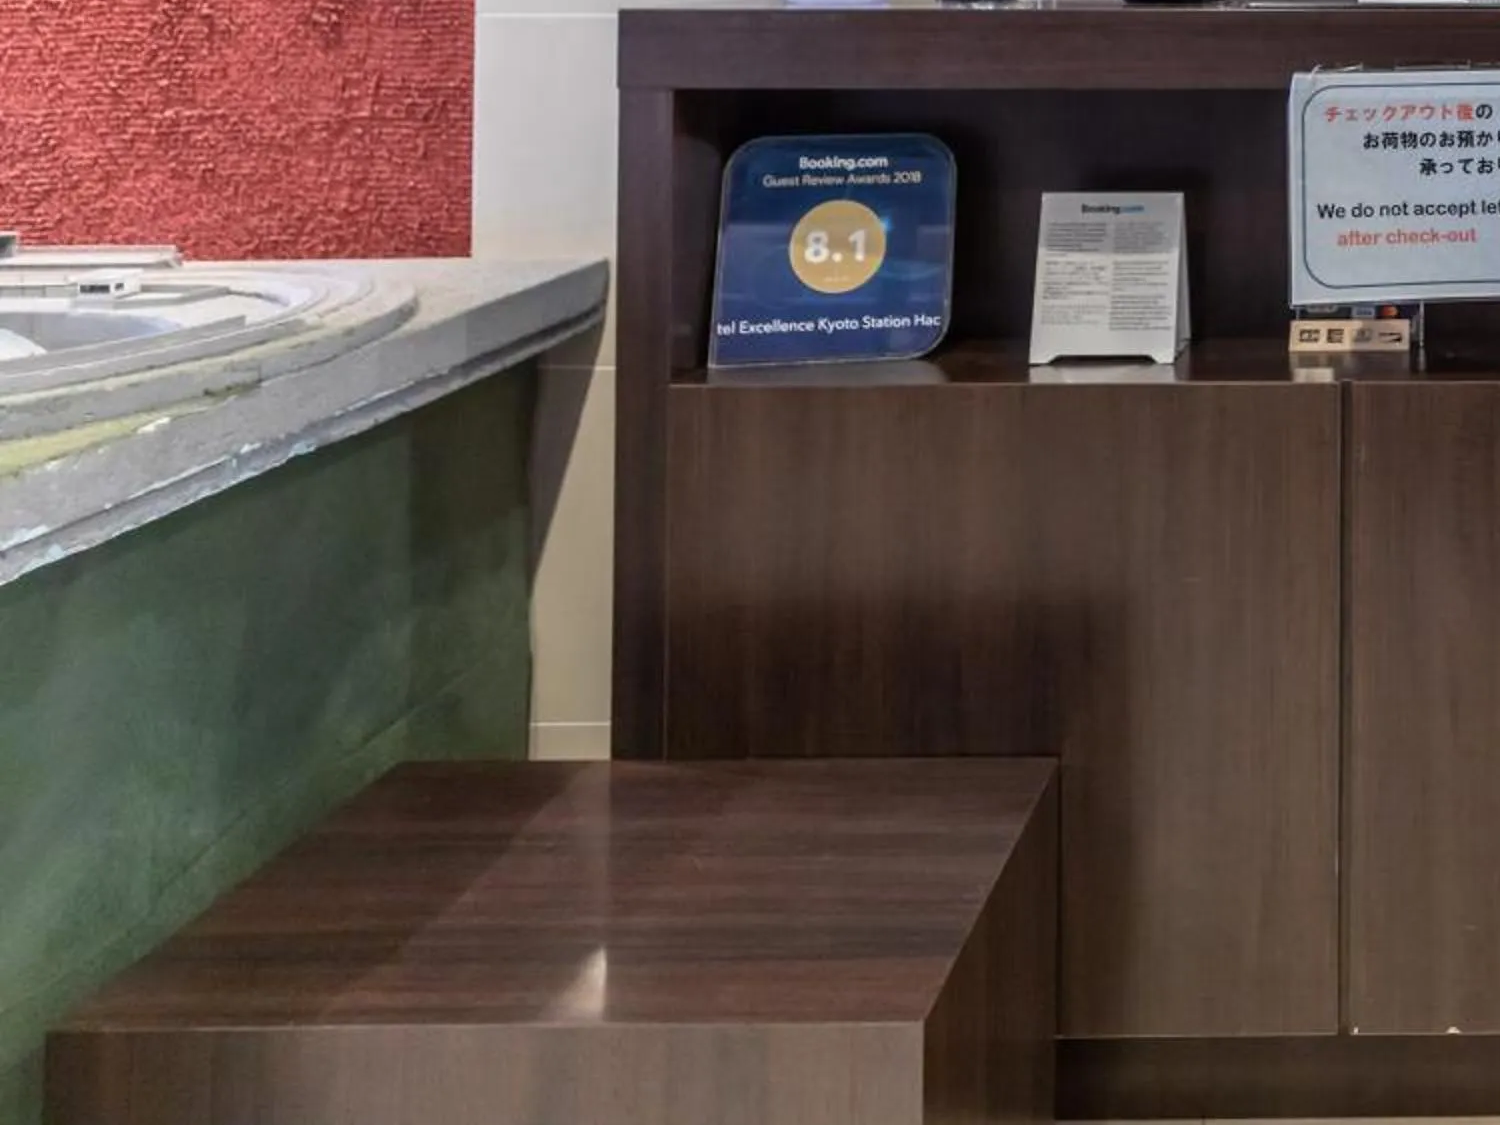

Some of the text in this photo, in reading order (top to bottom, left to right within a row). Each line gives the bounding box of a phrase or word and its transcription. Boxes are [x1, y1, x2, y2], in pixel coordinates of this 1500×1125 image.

[1324, 103, 1493, 123] チェックアウト後の
[799, 156, 888, 170] Booking.com
[762, 171, 922, 188] Guest Review Awards 2018
[1317, 203, 1346, 219] We
[1351, 202, 1374, 218] do
[1379, 201, 1409, 217] not
[1413, 201, 1478, 221] accept
[804, 230, 867, 263] 8.1
[1337, 227, 1477, 247] after check-out
[739, 318, 815, 334] Excellence
[818, 317, 859, 335] Kyoto
[862, 315, 911, 329] Station
[914, 314, 941, 327] Hac
